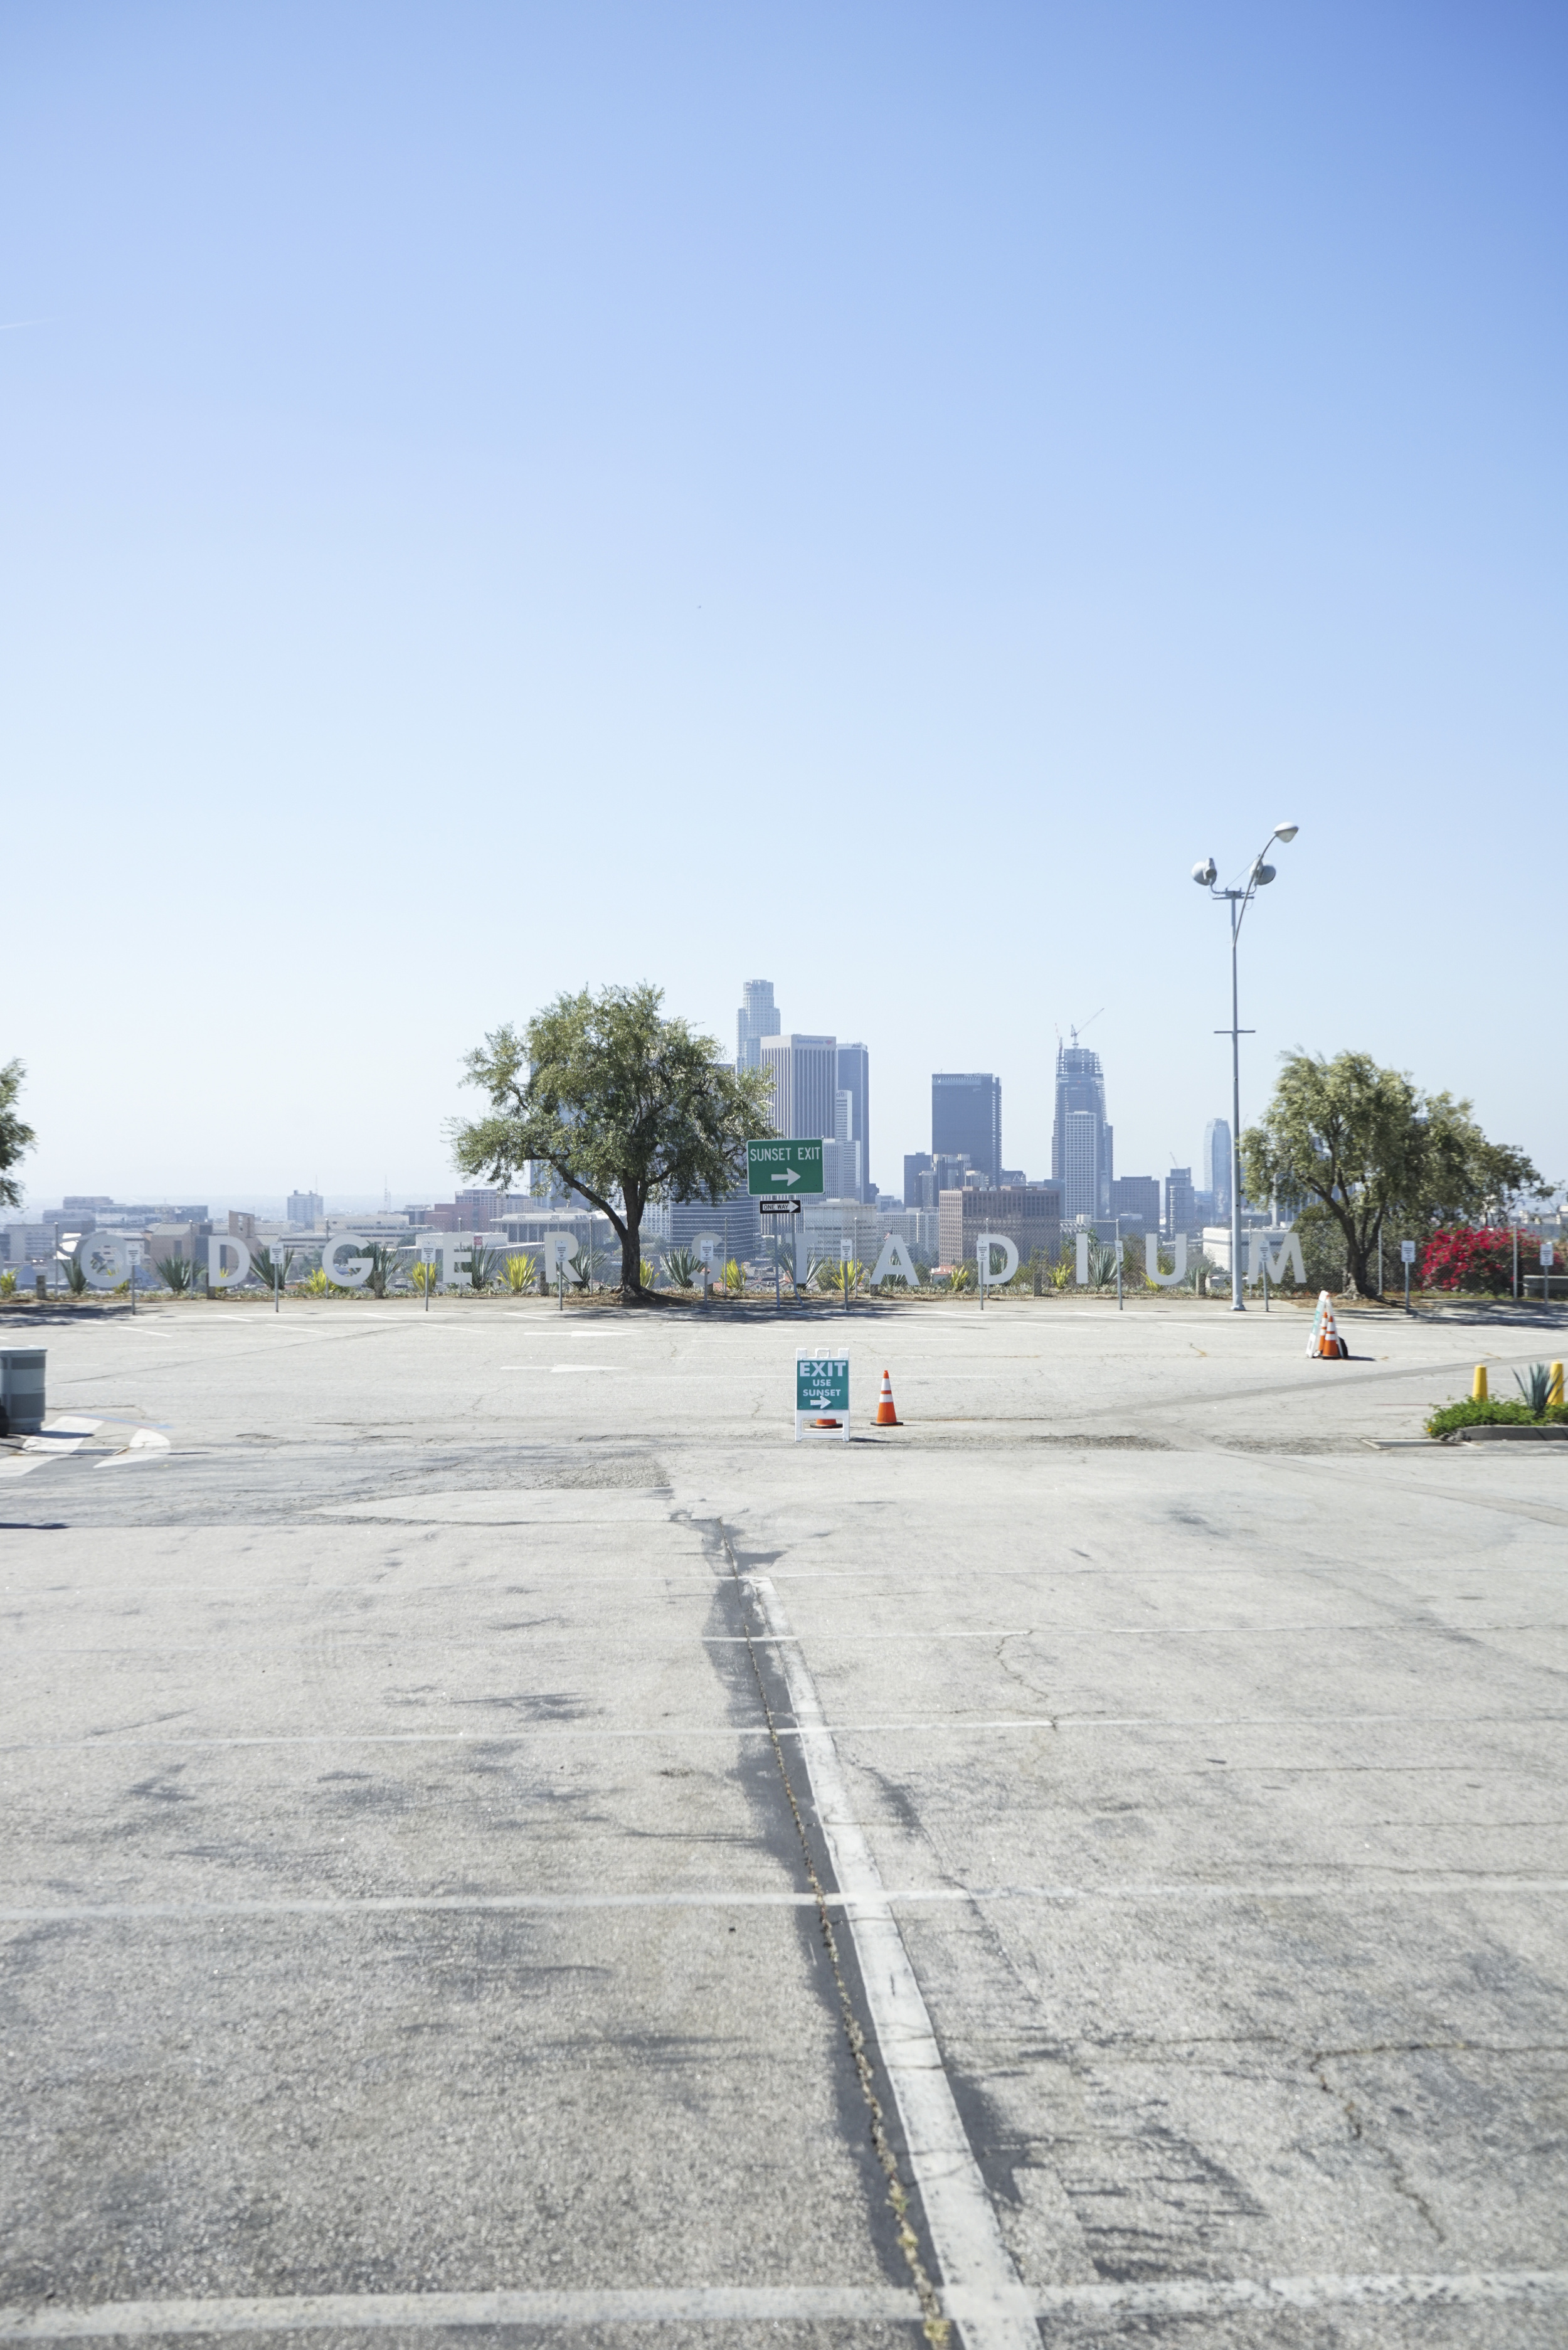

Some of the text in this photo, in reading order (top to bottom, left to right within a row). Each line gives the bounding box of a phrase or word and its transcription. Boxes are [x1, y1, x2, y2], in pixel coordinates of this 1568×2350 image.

[750, 1147, 820, 1161] SUNSET EXIT
[0, 1231, 587, 1287] ODGER
[800, 1362, 846, 1377] EXIT
